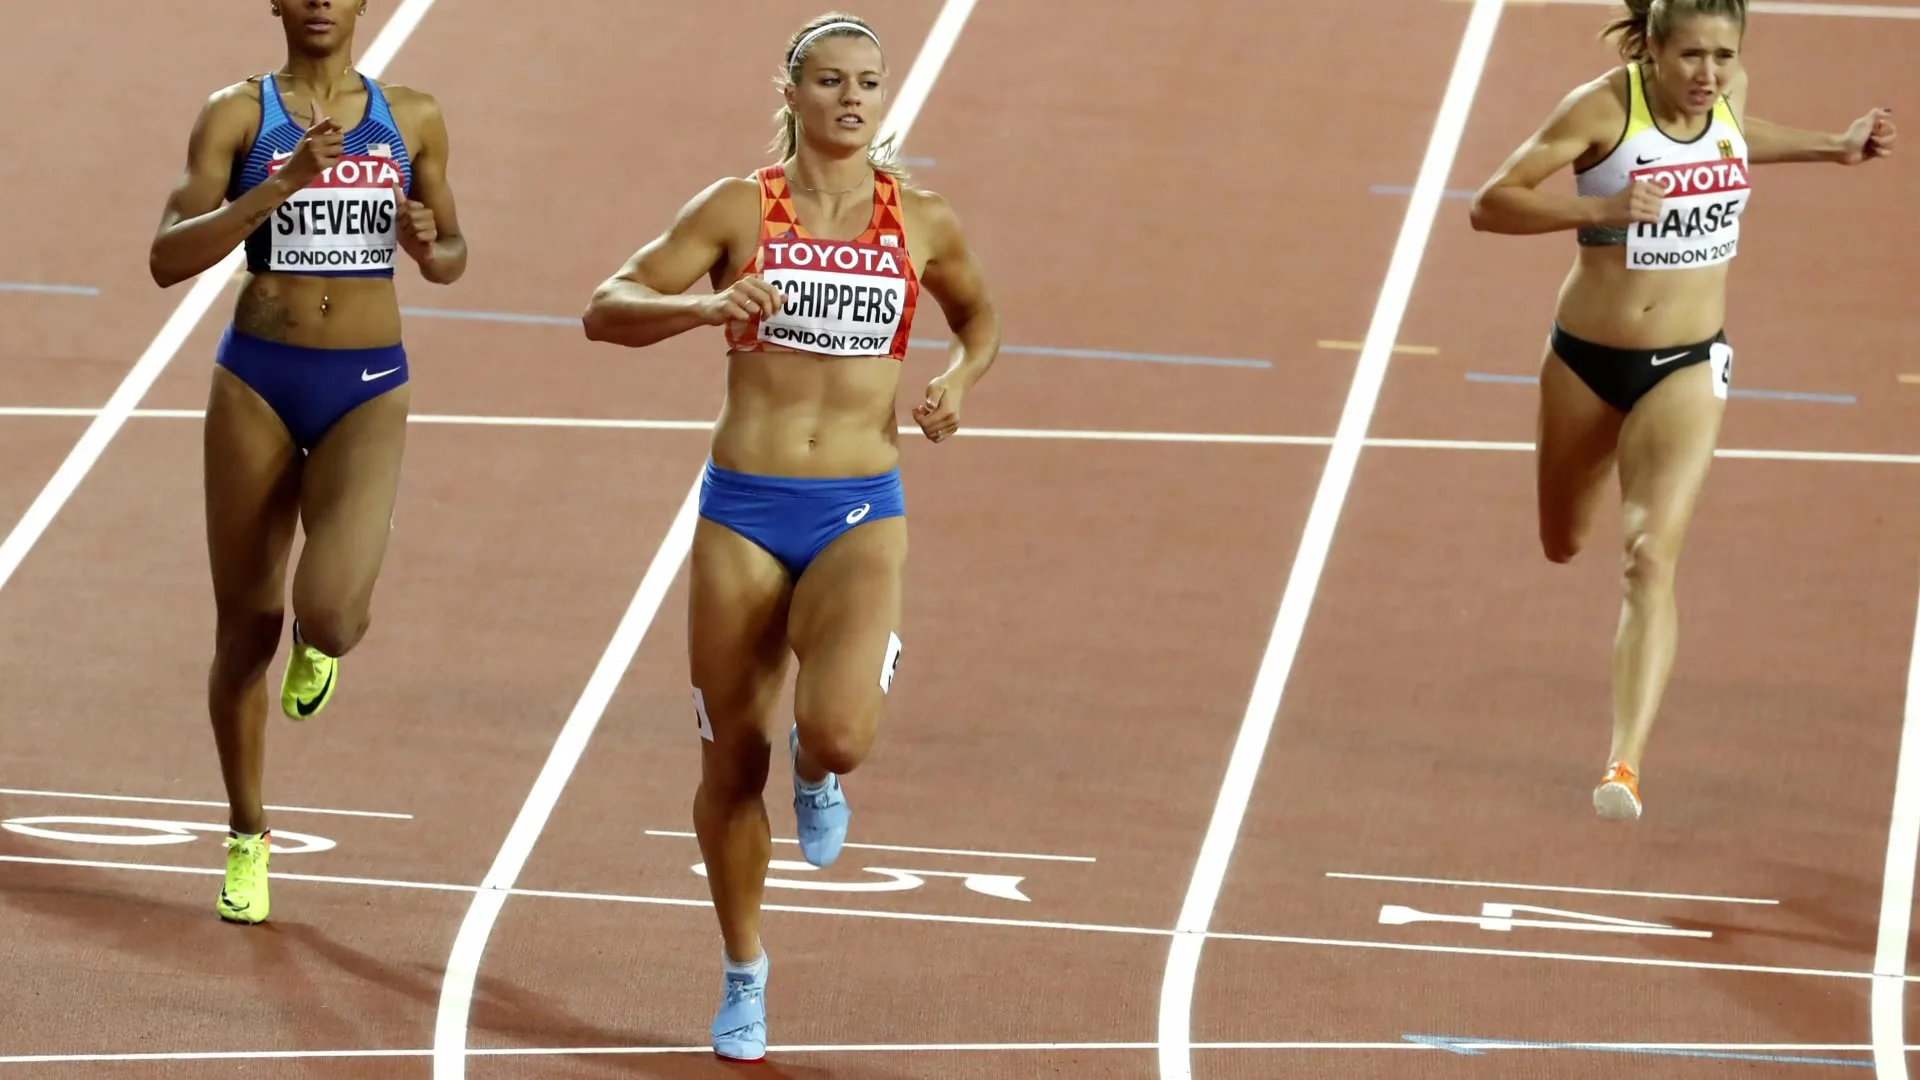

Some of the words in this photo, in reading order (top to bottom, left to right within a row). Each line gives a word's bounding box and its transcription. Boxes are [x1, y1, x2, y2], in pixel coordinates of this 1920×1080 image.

[271, 160, 400, 184] YOTA
[276, 199, 394, 236] STEVENS
[277, 250, 357, 266] LONDON
[360, 249, 394, 265] 2017
[768, 242, 900, 274] TOYOTA
[1633, 248, 1708, 265] LONDON
[764, 325, 846, 350] LONDON
[849, 336, 889, 350] 2017
[0, 815, 338, 854] 6
[691, 859, 1032, 902] 5
[1378, 902, 1713, 938] 4
